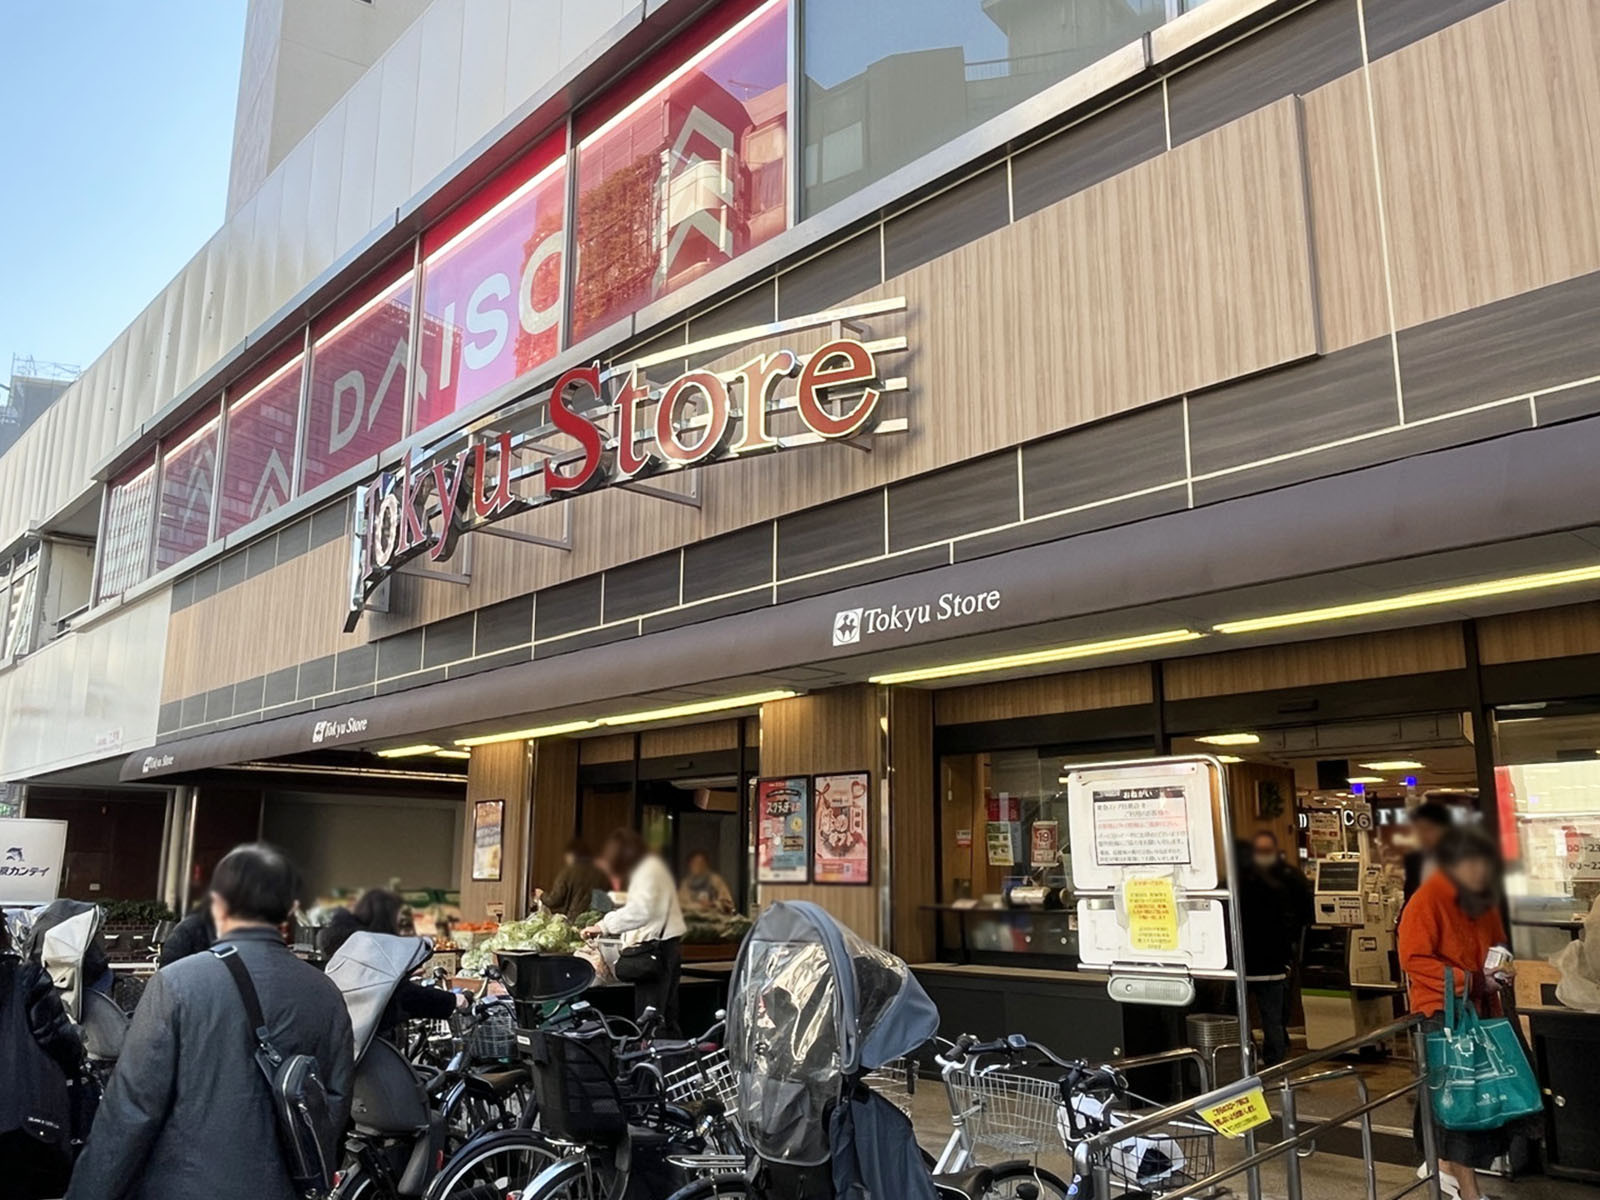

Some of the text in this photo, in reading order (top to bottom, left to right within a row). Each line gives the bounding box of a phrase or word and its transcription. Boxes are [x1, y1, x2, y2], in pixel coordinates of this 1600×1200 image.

[329, 230, 580, 455] DAISO
[361, 337, 881, 583] Tokyu Store
[864, 590, 1000, 633] Tokyu Store
[325, 717, 368, 738] Tokyu Store
[1357, 813, 1371, 829] 6
